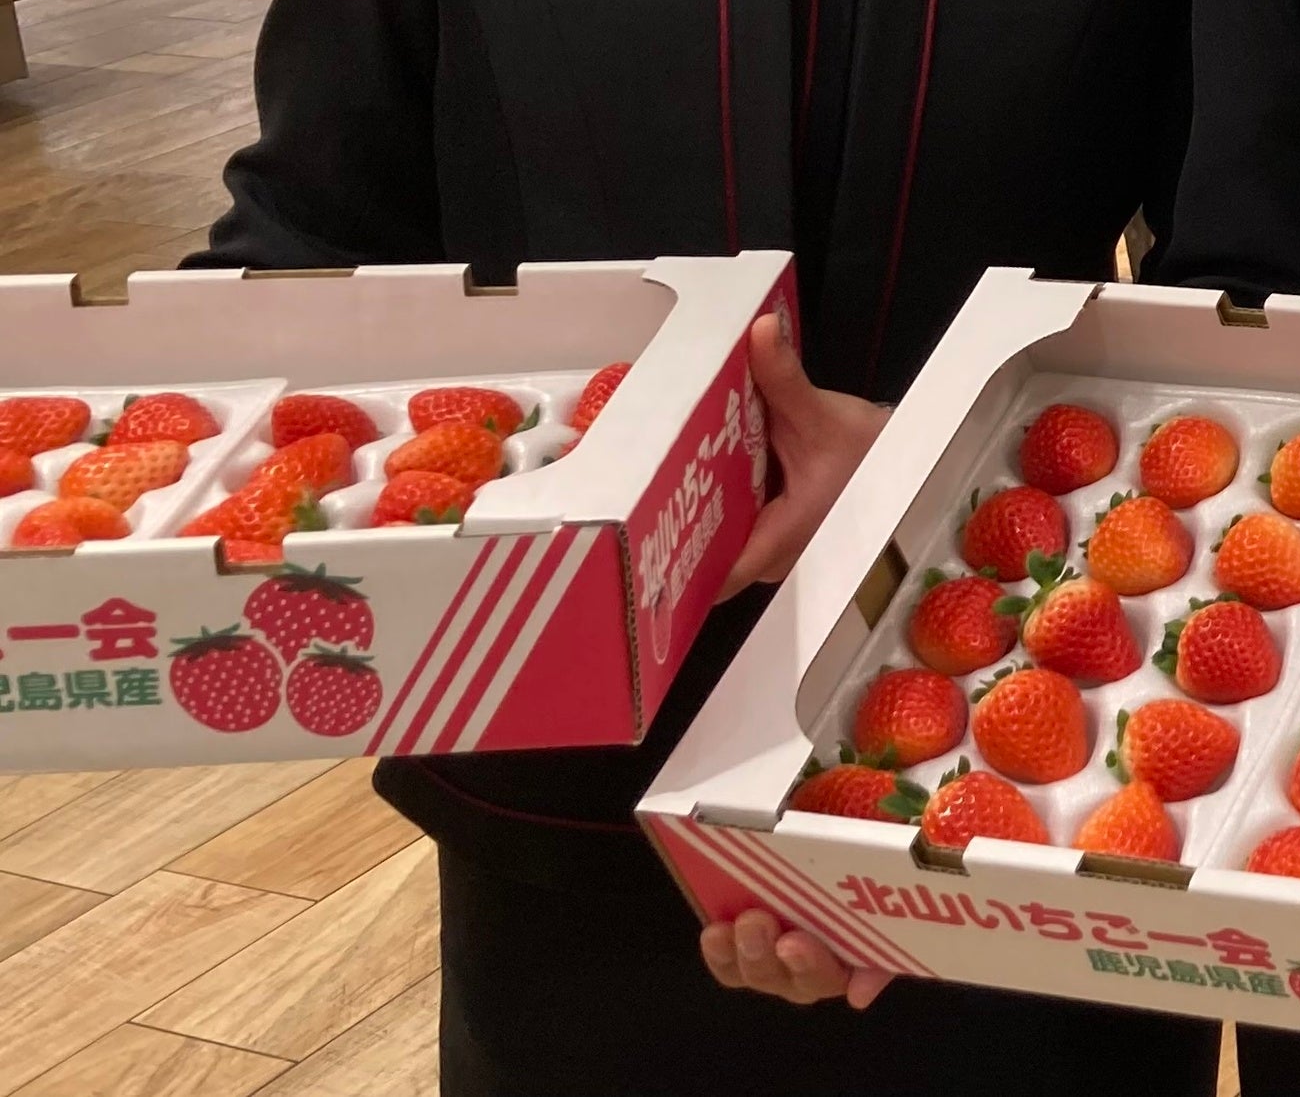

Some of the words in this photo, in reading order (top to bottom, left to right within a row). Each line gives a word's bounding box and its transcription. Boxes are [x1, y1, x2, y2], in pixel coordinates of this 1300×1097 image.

[0, 597, 159, 662] 一会
[836, 874, 1277, 971] 北山いちご一会
[1086, 947, 1290, 998] 鹿児島県産
